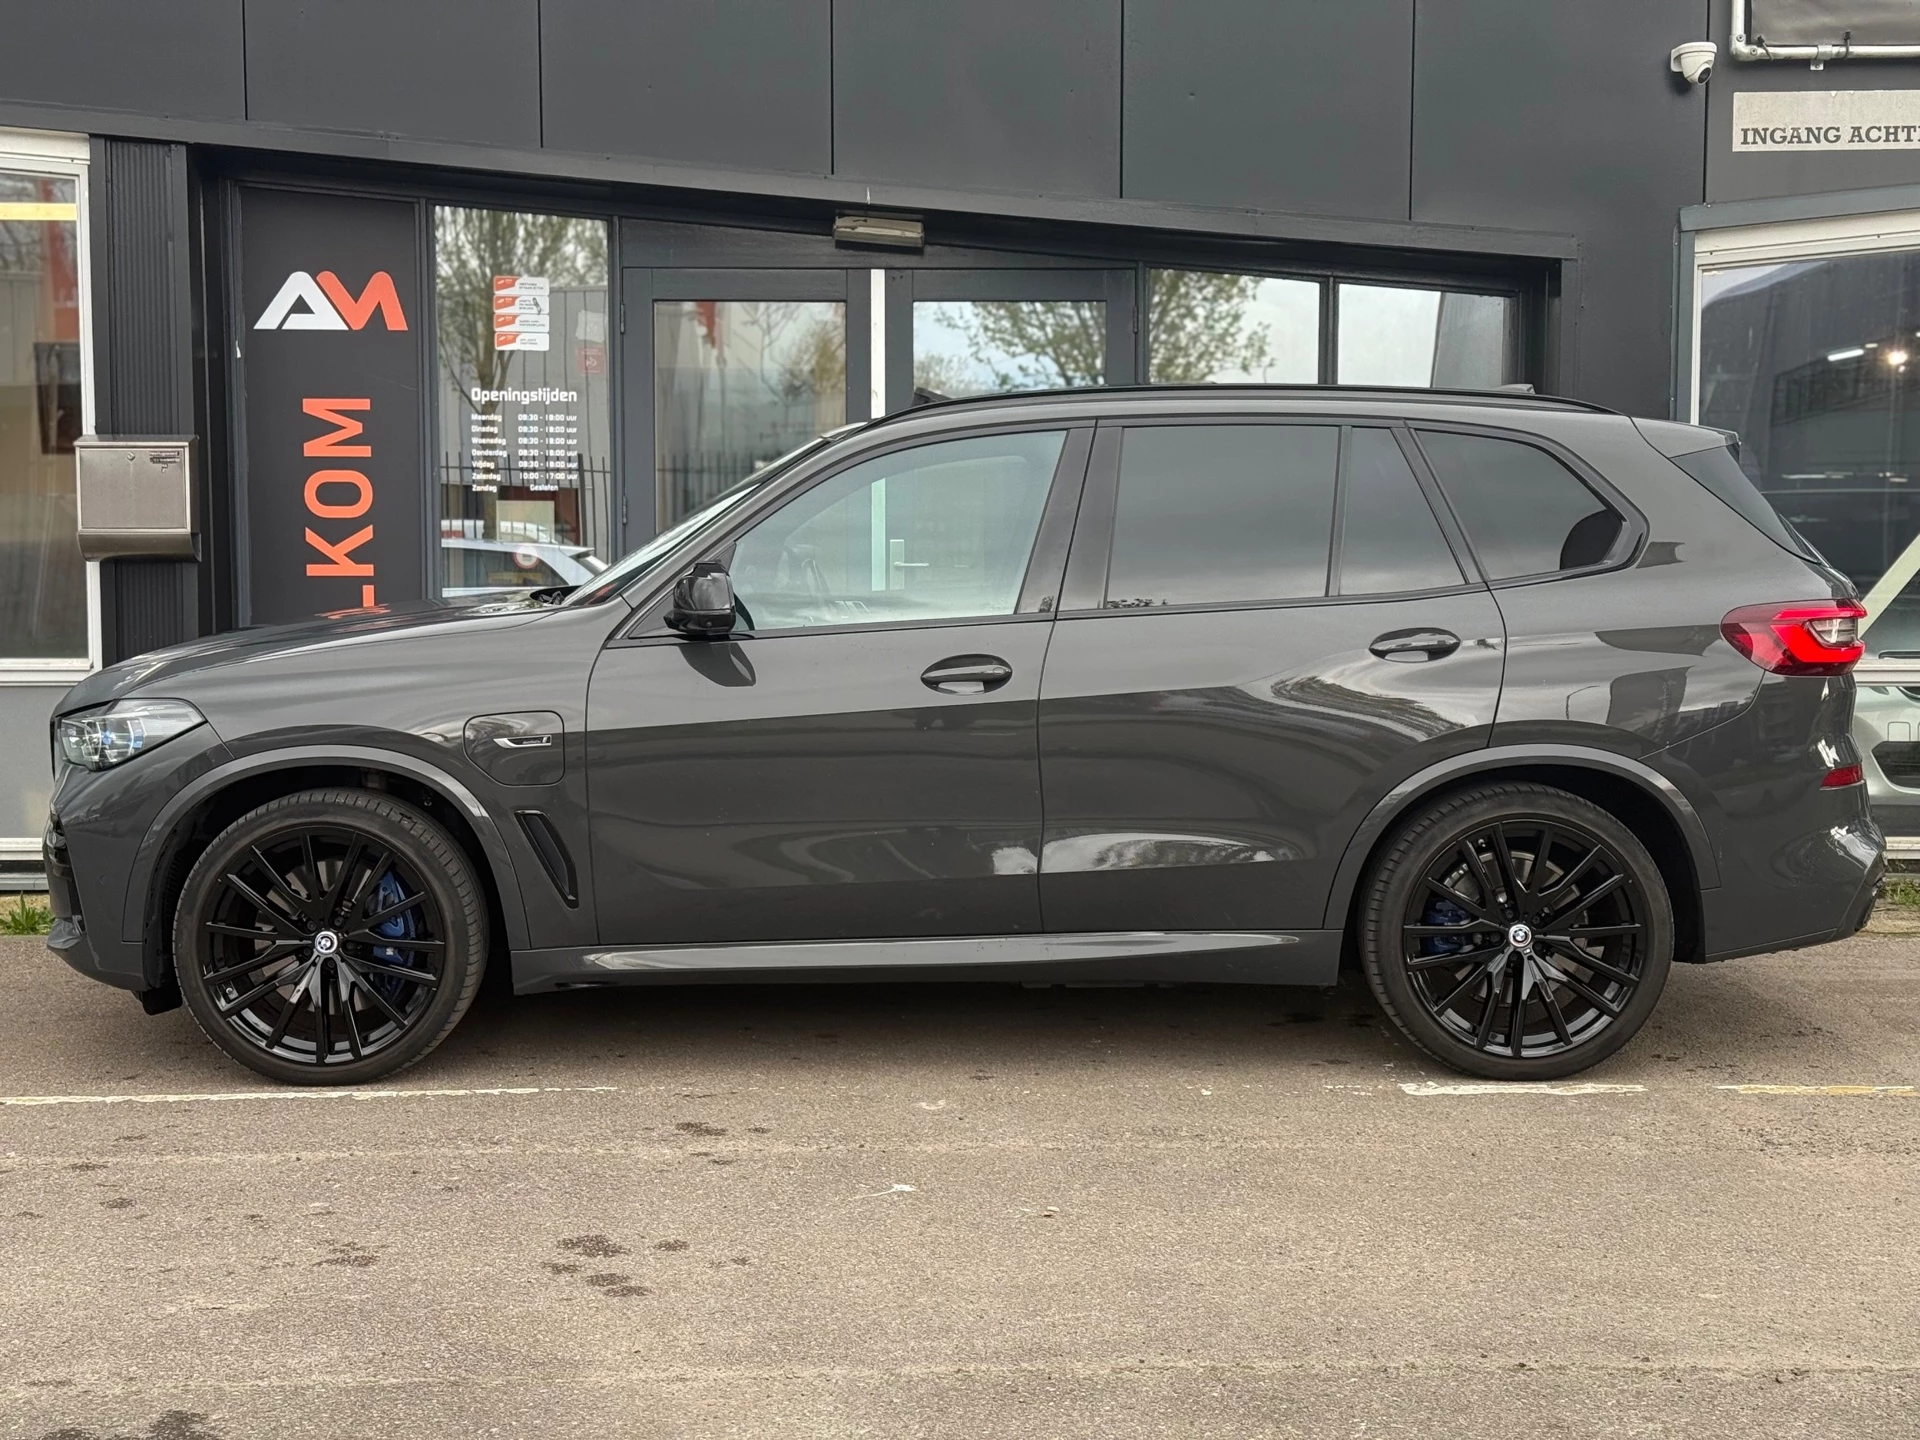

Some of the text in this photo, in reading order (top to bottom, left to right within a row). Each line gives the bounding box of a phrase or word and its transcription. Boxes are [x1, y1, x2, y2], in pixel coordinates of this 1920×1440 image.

[1740, 125, 1920, 145] INGANG ACHT
[471, 387, 578, 405] Openingstijden
[471, 414, 502, 422] Maandag
[471, 426, 498, 434] Dinsdag
[471, 437, 506, 445] Woensdag
[471, 449, 507, 457] Donderdag
[471, 461, 495, 469] Vrijdag
[471, 473, 501, 481] Zaterdag
[472, 485, 498, 493] Zondag
